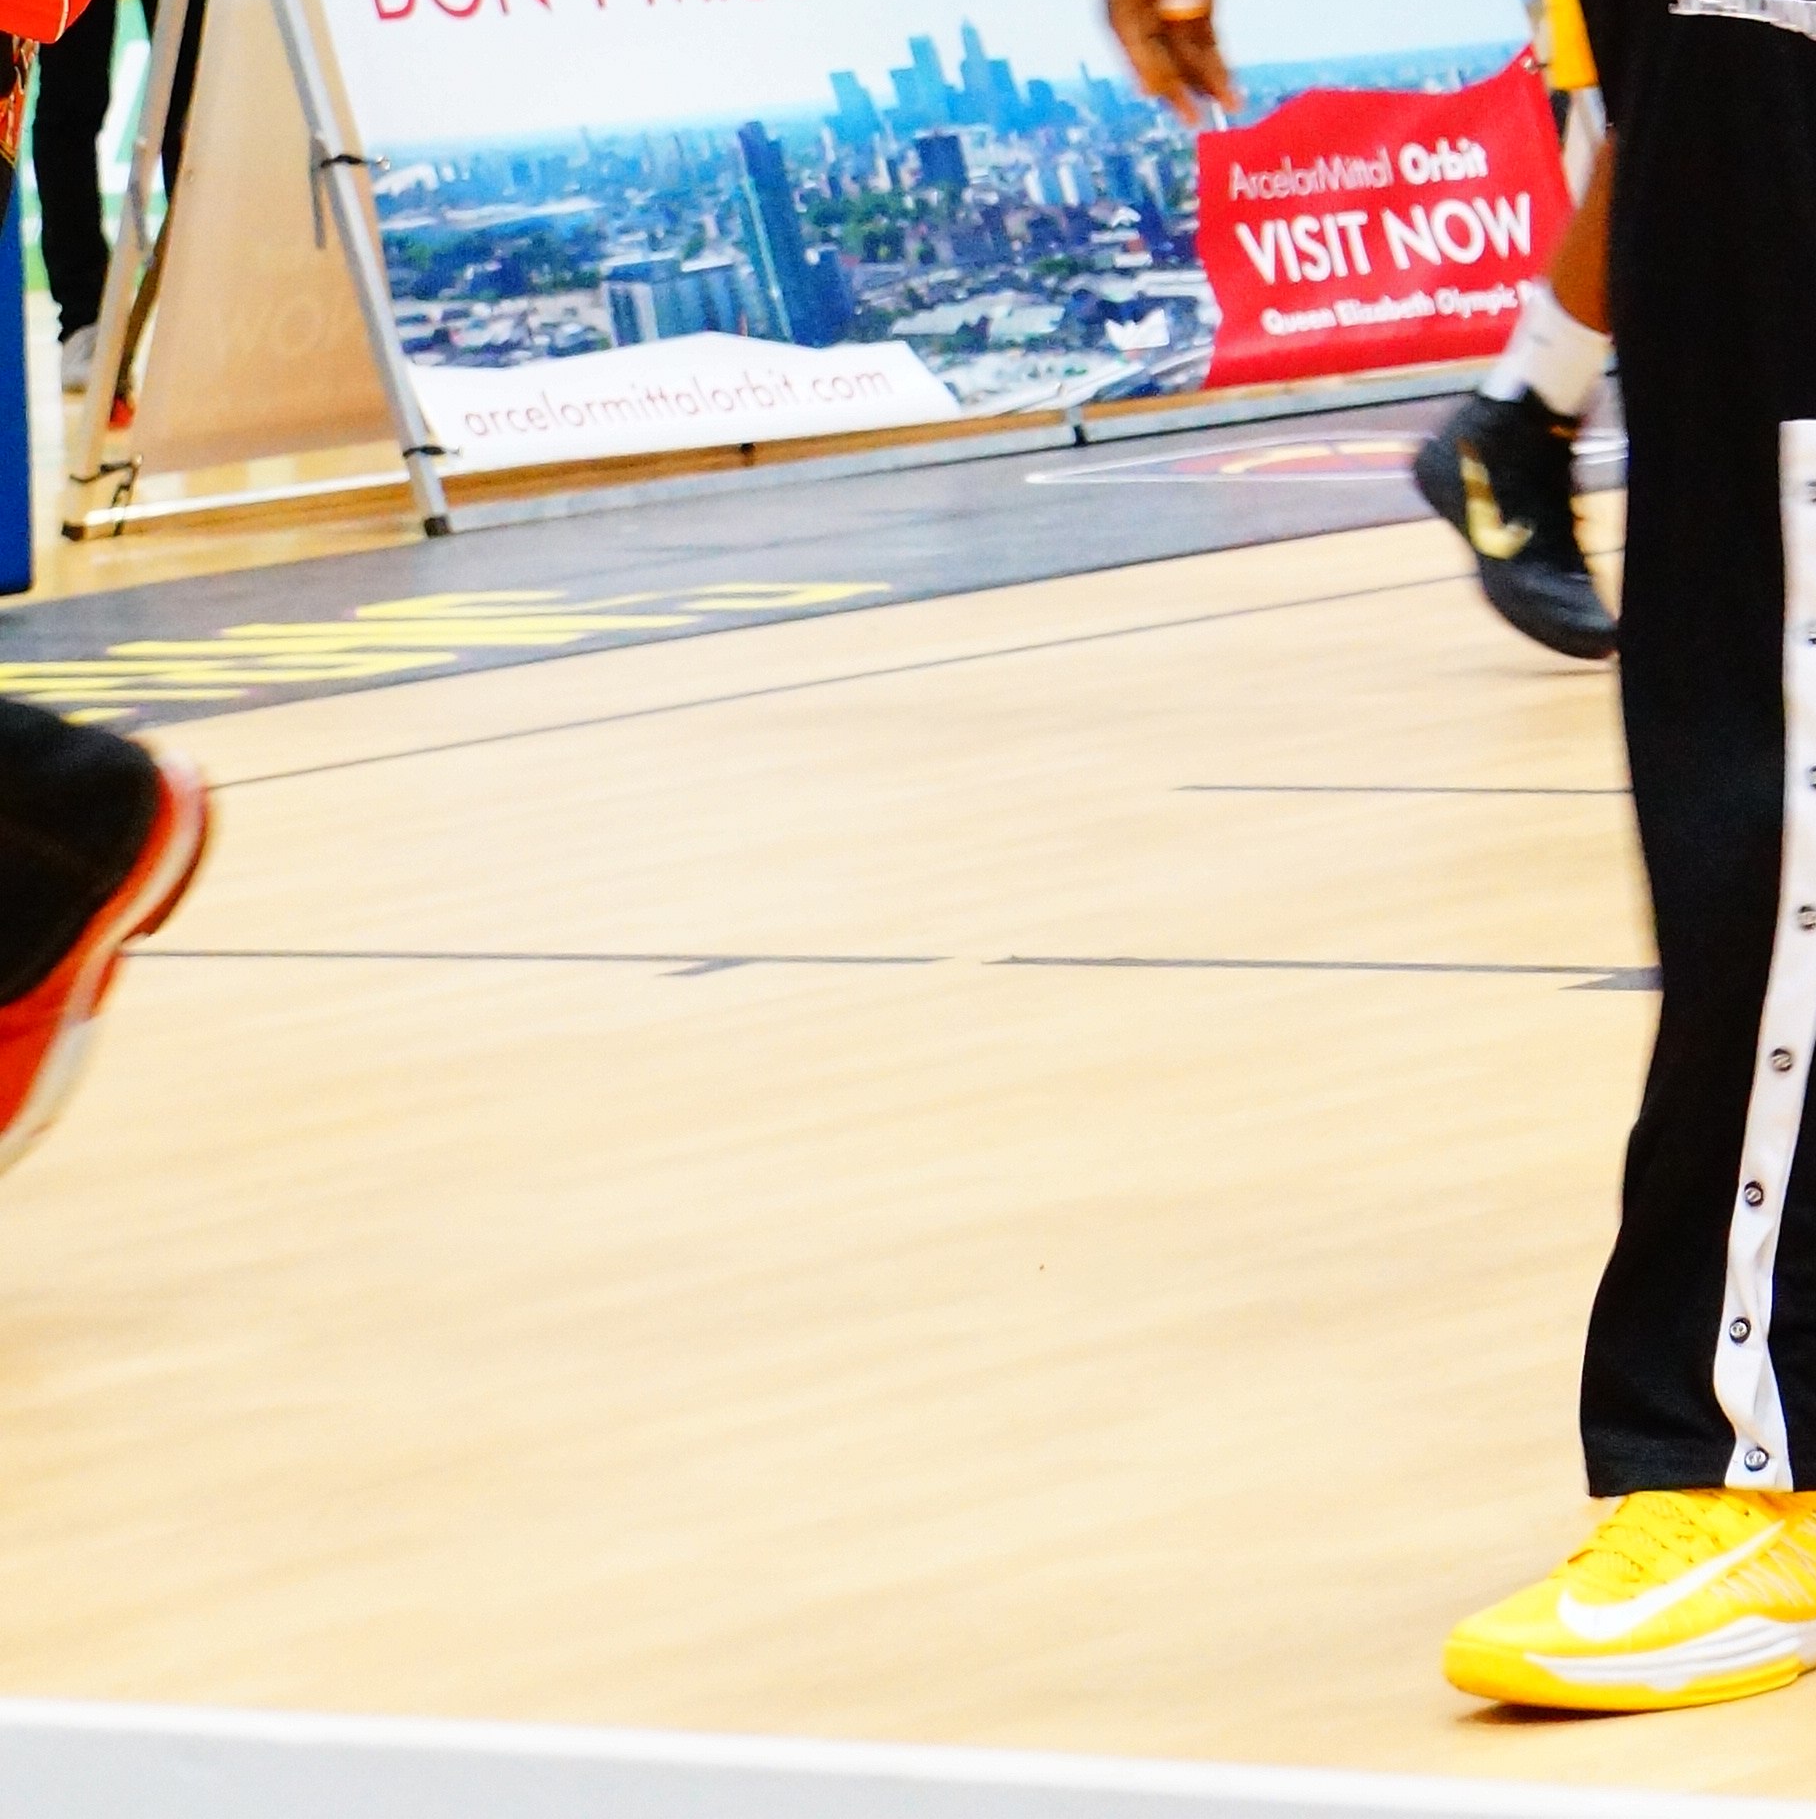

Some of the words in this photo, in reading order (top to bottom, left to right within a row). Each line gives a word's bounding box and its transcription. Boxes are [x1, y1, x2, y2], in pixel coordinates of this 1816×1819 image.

[1398, 136, 1488, 186] Orbit
[1234, 209, 1372, 285] VISIT
[1380, 191, 1531, 271] NOW
